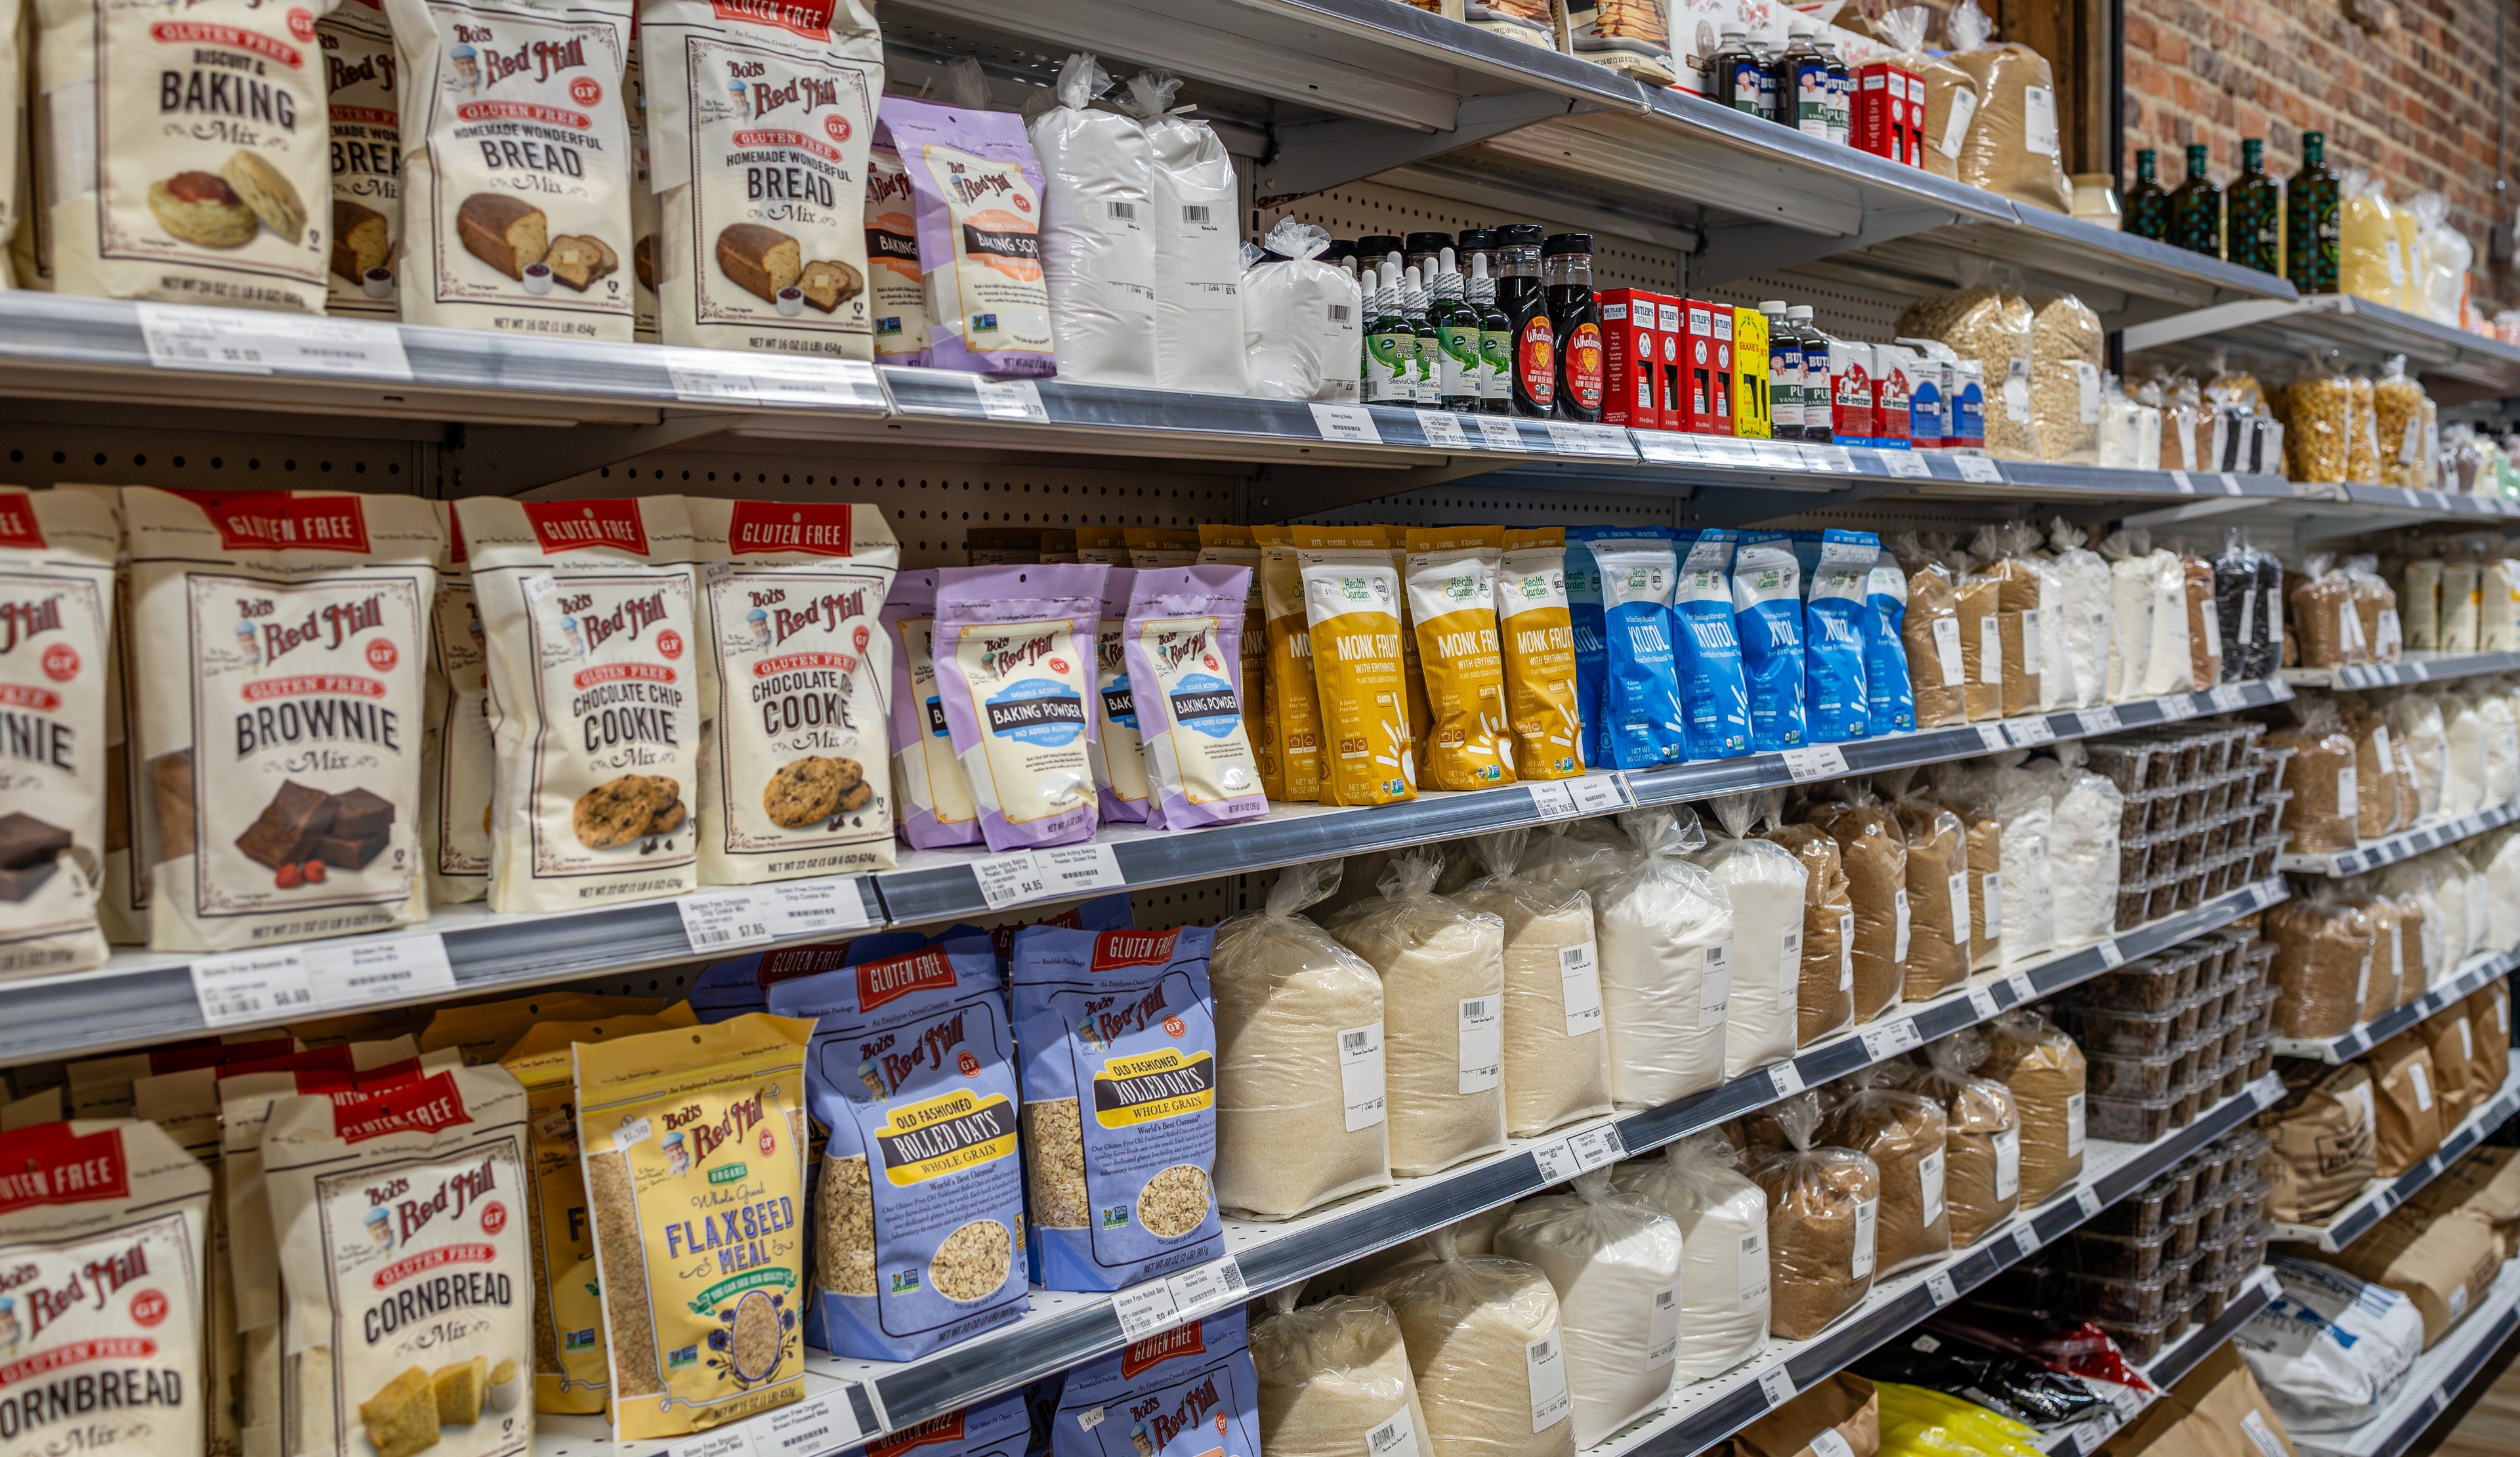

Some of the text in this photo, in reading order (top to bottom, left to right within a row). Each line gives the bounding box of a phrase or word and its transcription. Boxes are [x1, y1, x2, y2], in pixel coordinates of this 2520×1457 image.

[483, 35, 587, 89] Red Mill
[726, 60, 765, 78] Bob's
[159, 70, 297, 133] BAKING
[753, 77, 838, 120] Red Mill
[467, 106, 579, 125] GLUTEN FREE
[828, 122, 847, 133] GF
[741, 131, 833, 158] GLUTEN FREE
[480, 140, 584, 179] BREAD
[726, 150, 852, 182] HOMEMADE WONDERFUL
[747, 167, 834, 209] BREAD
[768, 204, 816, 223] Mix
[1634, 305, 1654, 317] BUTLER'S
[1660, 310, 1678, 320] BUTLER'S
[1691, 314, 1710, 324] BUTLER'S
[1662, 319, 1676, 327] EXTRACTS
[1693, 323, 1708, 331] EXTRACTS
[1715, 319, 1731, 329] BUTLER'S
[1740, 342, 1759, 352] SHANK'S
[543, 519, 636, 541] GLUTEN FREE
[742, 522, 841, 545] GLUTEN FREE
[1345, 577, 1366, 589] Health
[1450, 575, 1473, 587] Health
[1524, 577, 1545, 587] Health
[1632, 568, 1647, 578] Health
[748, 589, 786, 608] Bob's
[1343, 587, 1370, 603] Garden
[582, 591, 667, 654] Red Mill
[772, 587, 866, 646] Red Mill
[262, 612, 320, 666] Red
[322, 594, 384, 651] Mill
[1157, 631, 1177, 646] Bob's
[1517, 626, 1574, 655] MONK FRUIT
[1628, 625, 1670, 654] XYLITOL
[1690, 622, 1738, 649] XYLITOL
[1336, 634, 1400, 661] MONK FRUIT
[1529, 652, 1571, 665] WITH ERYTHRITOL
[1354, 662, 1396, 674] WITH ERYTHRITOL
[1457, 656, 1500, 669] WITH ERYTHRITOL
[752, 670, 839, 703] CHOCOLATE
[1011, 686, 1061, 699] DOUBLE ACTING
[573, 683, 682, 718] CHOCOLATE CHIP
[1175, 695, 1238, 715] BAKING POWDER
[763, 692, 860, 736] COOKIE
[992, 701, 1082, 725] BAKING POWDER
[236, 698, 400, 761] BROWNIE
[585, 706, 679, 755] COOKIE
[1050, 850, 1065, 859] Double
[1072, 855, 1085, 863] Gluten
[1021, 880, 1043, 893] $4.85
[1110, 935, 1177, 959] GLUTEN FREE
[870, 952, 943, 994] GLUTEN FREE
[1084, 996, 1115, 1016] Bob's
[1166, 1022, 1181, 1032] GF
[881, 1009, 967, 1097] Red Mill
[1113, 1055, 1179, 1077] OLD FASHIONED
[1112, 1067, 1205, 1107] ROLLED OATS
[662, 1103, 703, 1131] Bob's
[896, 1098, 973, 1130] OLD FASHIONED
[1133, 1096, 1202, 1118] WHOLE GRAIN
[690, 1089, 765, 1168] Red Mill
[892, 1110, 1001, 1163] ROLLED OATS
[1137, 1124, 1161, 1135] World's
[1144, 1134, 1166, 1143] Fashioned
[921, 1143, 997, 1175] WHOLE GRAIN
[710, 1164, 746, 1183] ORGANIC
[396, 1158, 496, 1248] Red Mill
[665, 1196, 794, 1259] FLAXSEED
[719, 1239, 771, 1275] MEAL
[1183, 1269, 1205, 1282] Gluten Free
[1185, 1276, 1208, 1288] Rolled Oats
[1119, 1286, 1165, 1307] Gluten Free Rolled Oats
[364, 1272, 513, 1345] CORNBREAD
[1135, 1323, 1191, 1362] GLUTEN FREE
[791, 1409, 803, 1418] Free
[805, 1401, 825, 1412] Organic
[1130, 1396, 1160, 1423] Bob's
[1150, 1374, 1221, 1457] Red Mill
